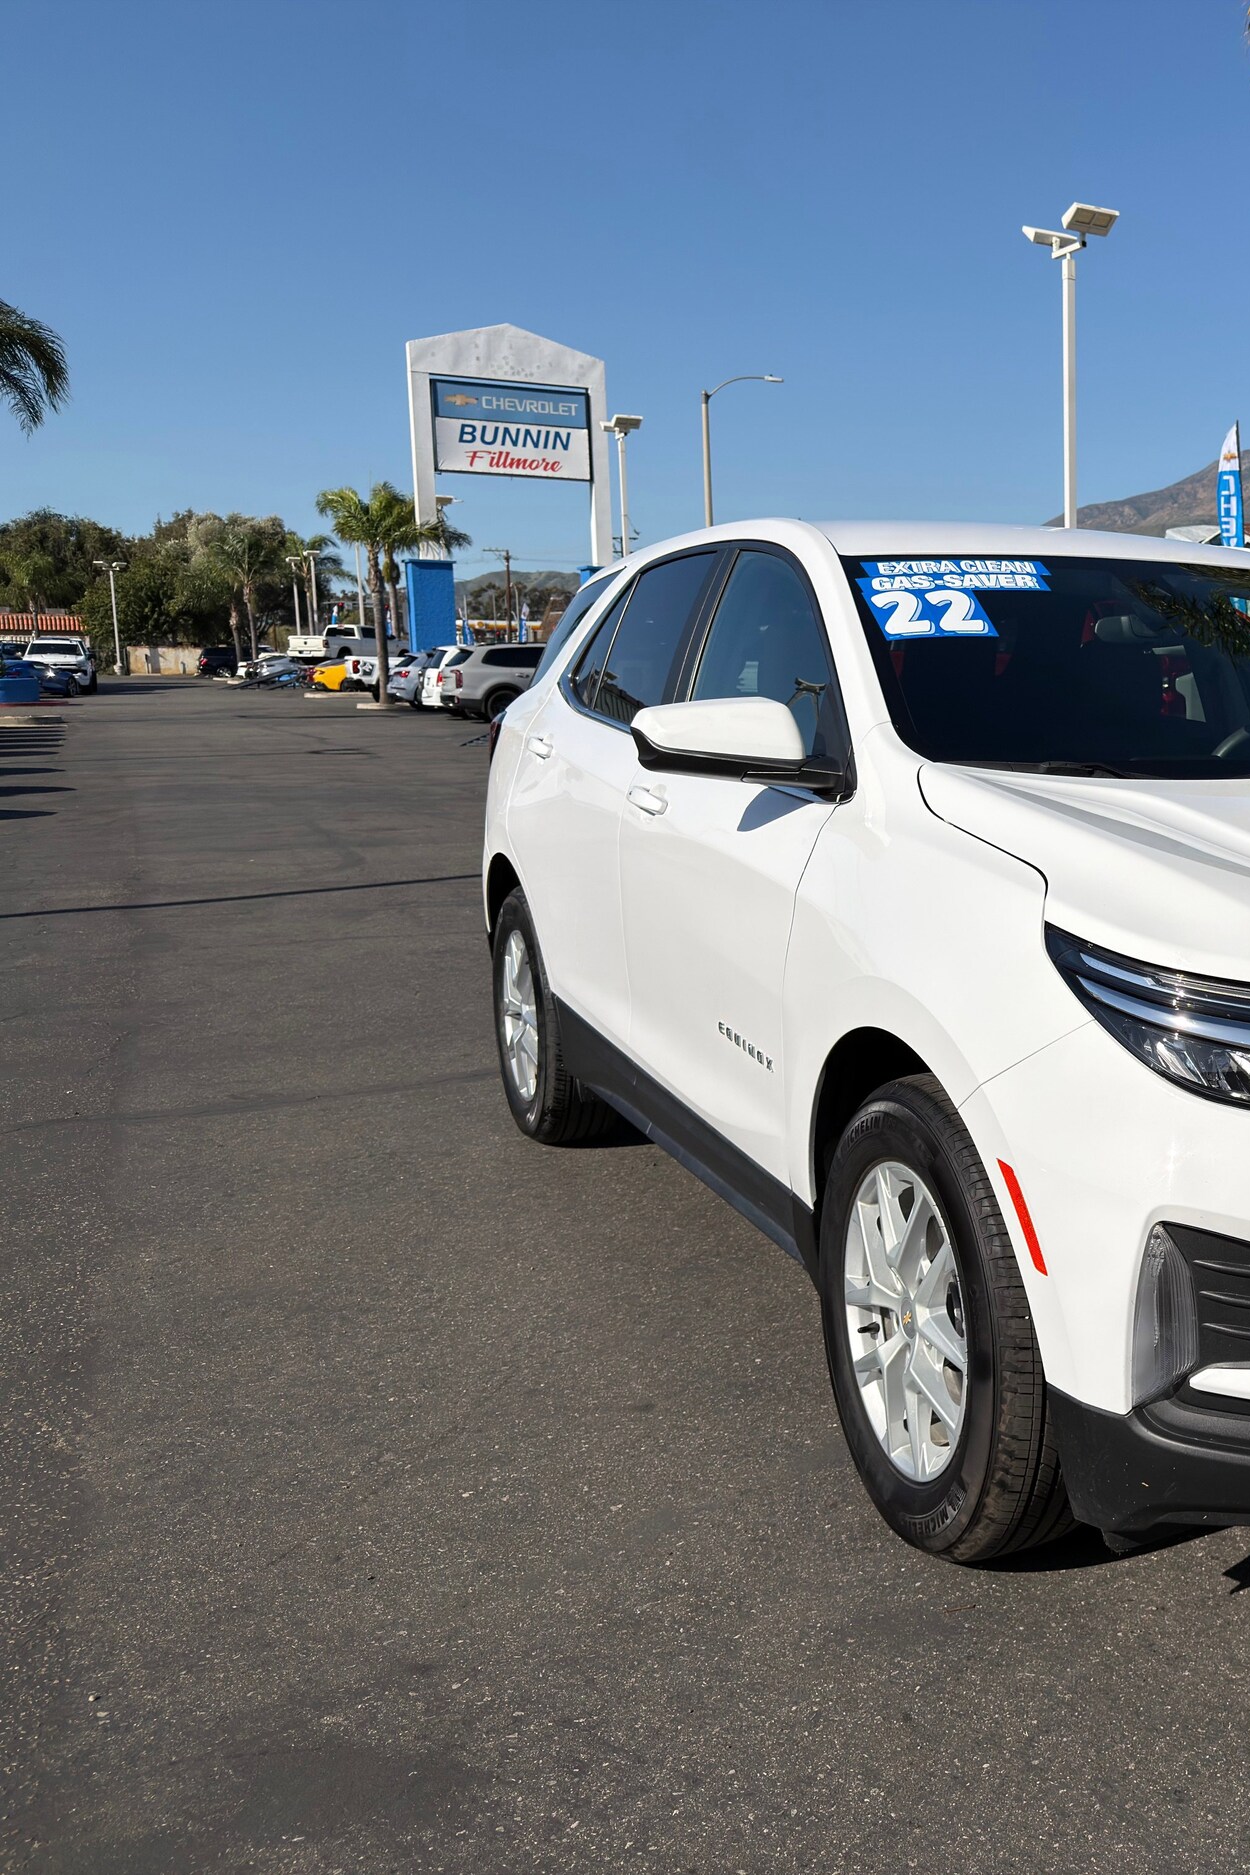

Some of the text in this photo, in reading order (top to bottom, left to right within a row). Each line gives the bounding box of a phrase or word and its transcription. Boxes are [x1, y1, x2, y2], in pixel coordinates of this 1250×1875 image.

[481, 395, 578, 417] CHEVROLET
[458, 423, 571, 451] BUNNIN
[465, 450, 563, 473] Fillmore
[876, 560, 1038, 575] EXTRA CLEAN
[871, 574, 1041, 591] GAS-SAVER
[870, 589, 989, 636] 22
[718, 1021, 774, 1074] EQUINOX
